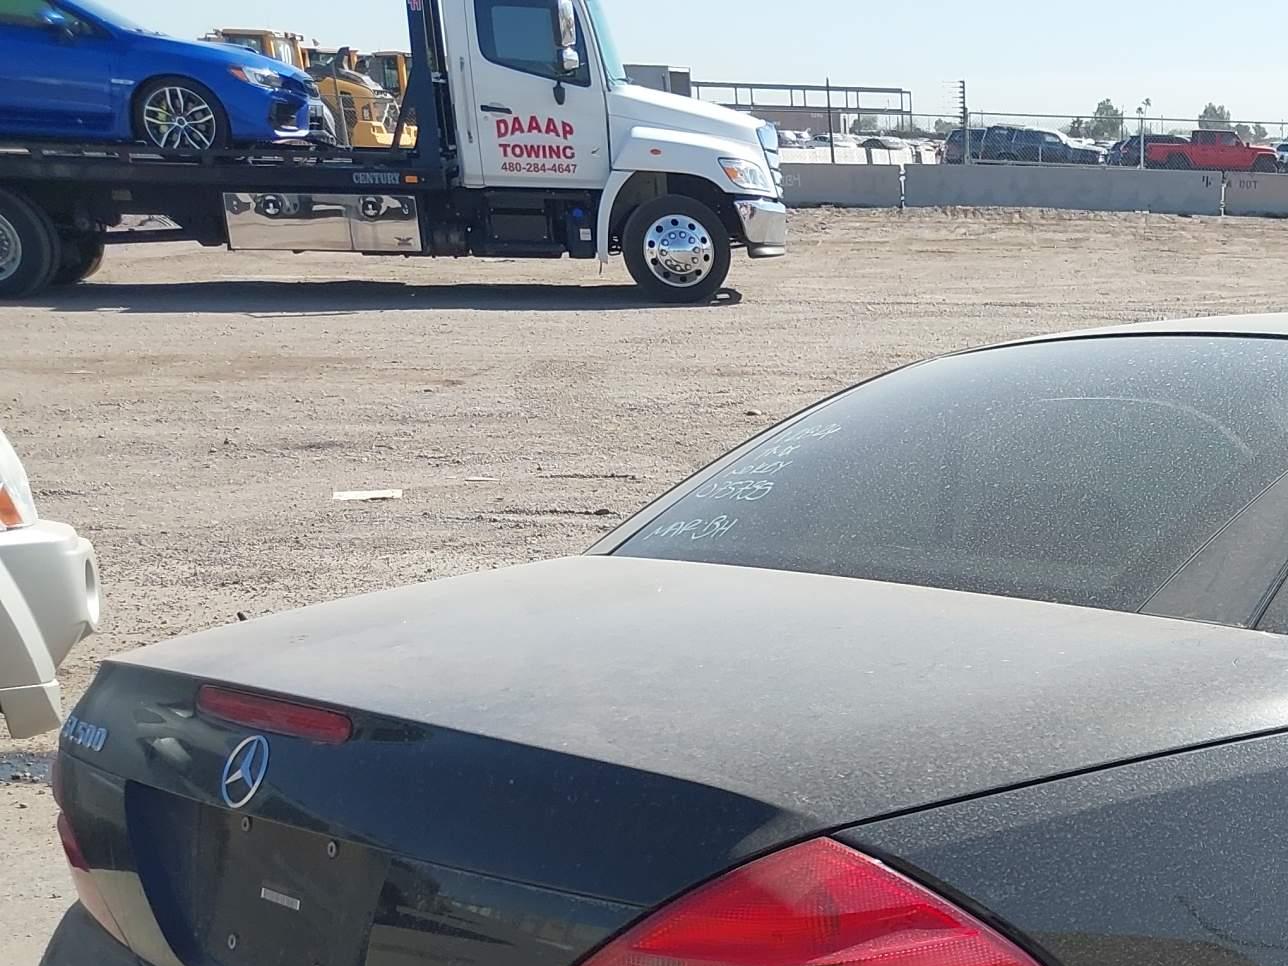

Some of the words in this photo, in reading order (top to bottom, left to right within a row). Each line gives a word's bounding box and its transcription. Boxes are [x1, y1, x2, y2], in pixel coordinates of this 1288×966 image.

[496, 115, 574, 140] DAAAP
[499, 143, 575, 160] TOWING
[501, 161, 577, 174] 480-284-4647
[353, 172, 400, 184] CENTURY
